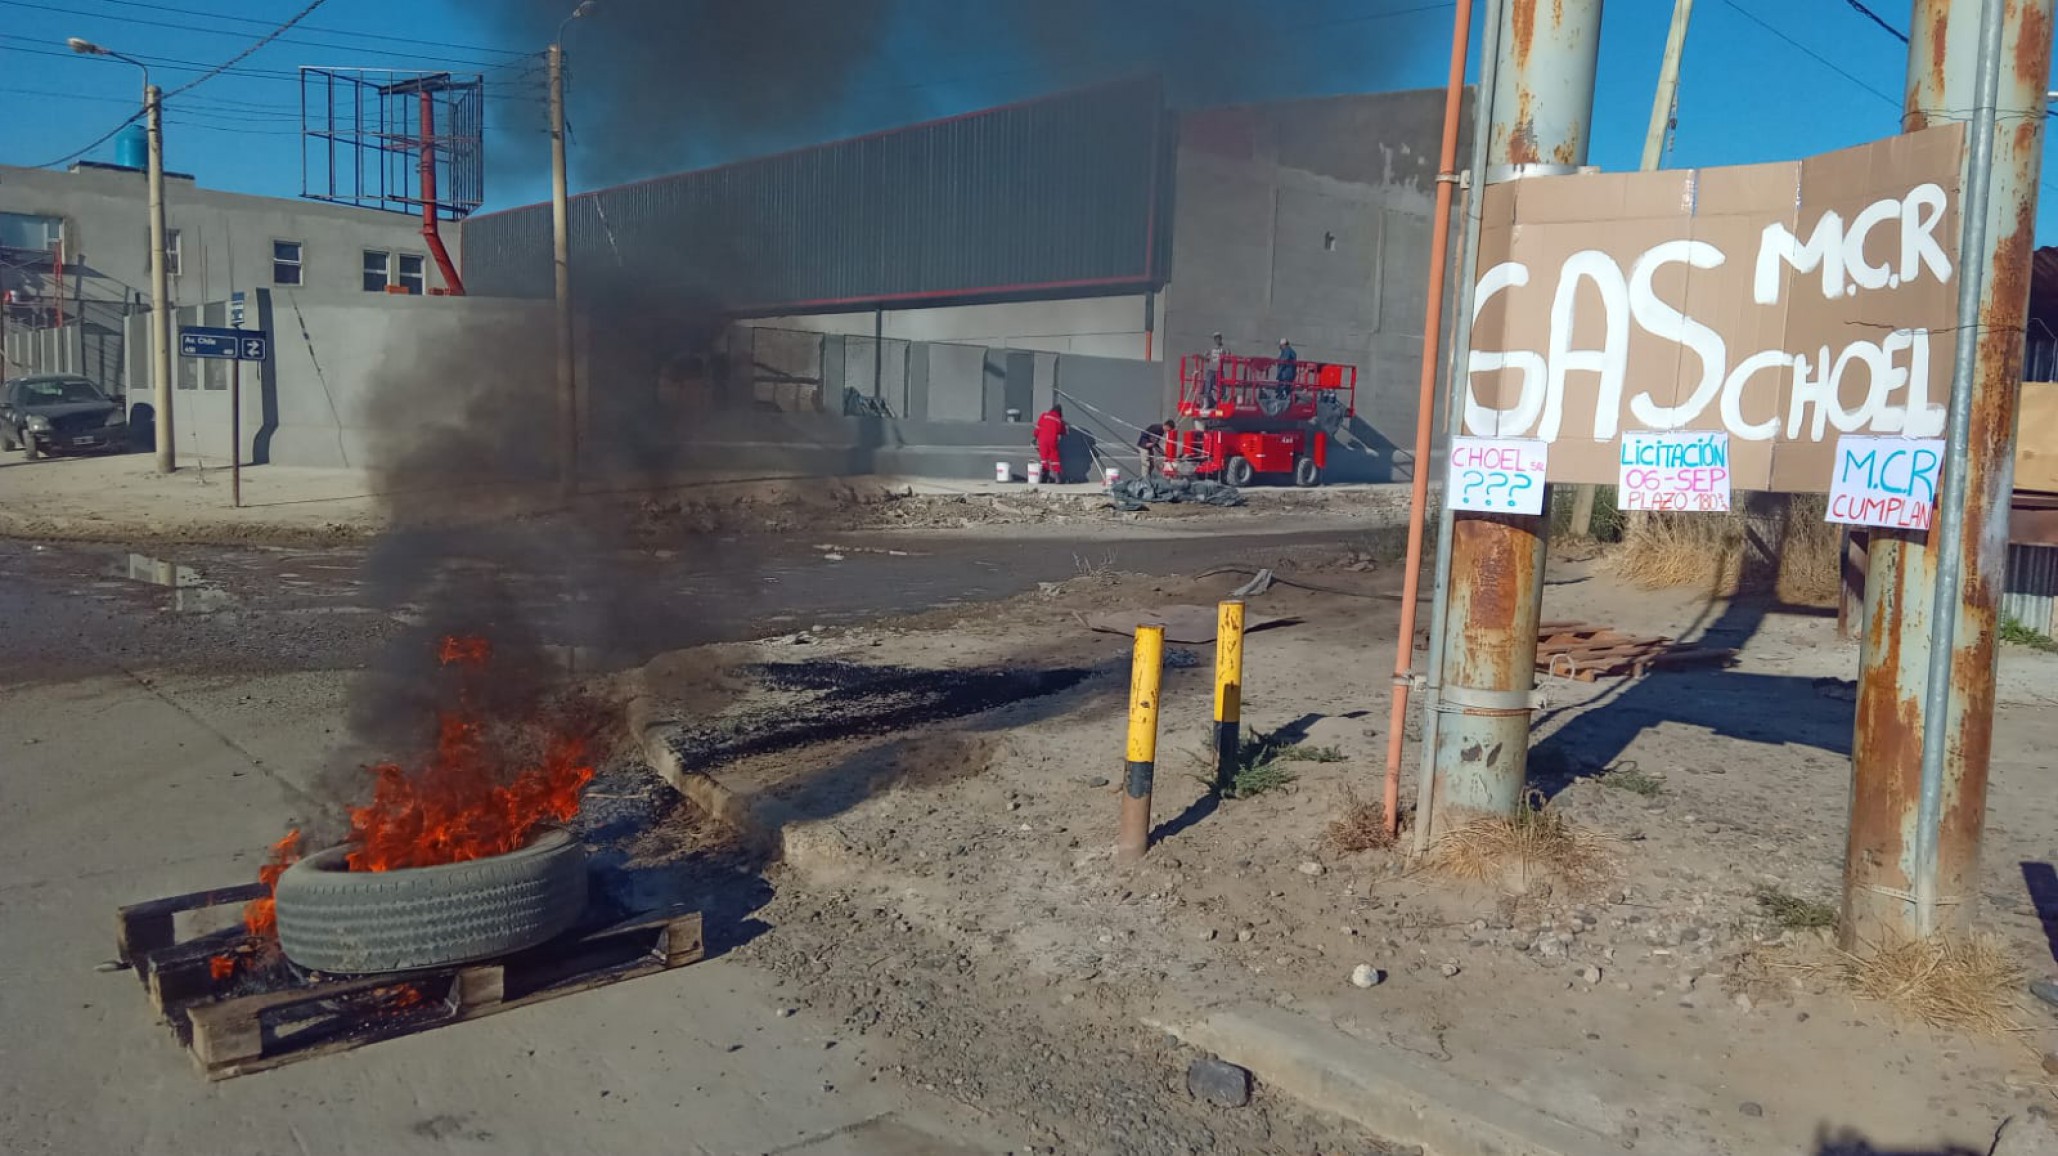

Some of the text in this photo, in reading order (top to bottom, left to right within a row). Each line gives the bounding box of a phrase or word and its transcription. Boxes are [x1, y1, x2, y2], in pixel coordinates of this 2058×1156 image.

[1753, 183, 1953, 304] M.C.R
[1464, 239, 1727, 442] GAS
[1720, 327, 1947, 442] CHOEL
[1452, 447, 1527, 472] CHOEL
[1842, 448, 1938, 503] M.C.R
[1462, 470, 1532, 507] ???
[1628, 491, 1689, 512] PLAZO
[1832, 494, 1934, 530] CUMPLAN
